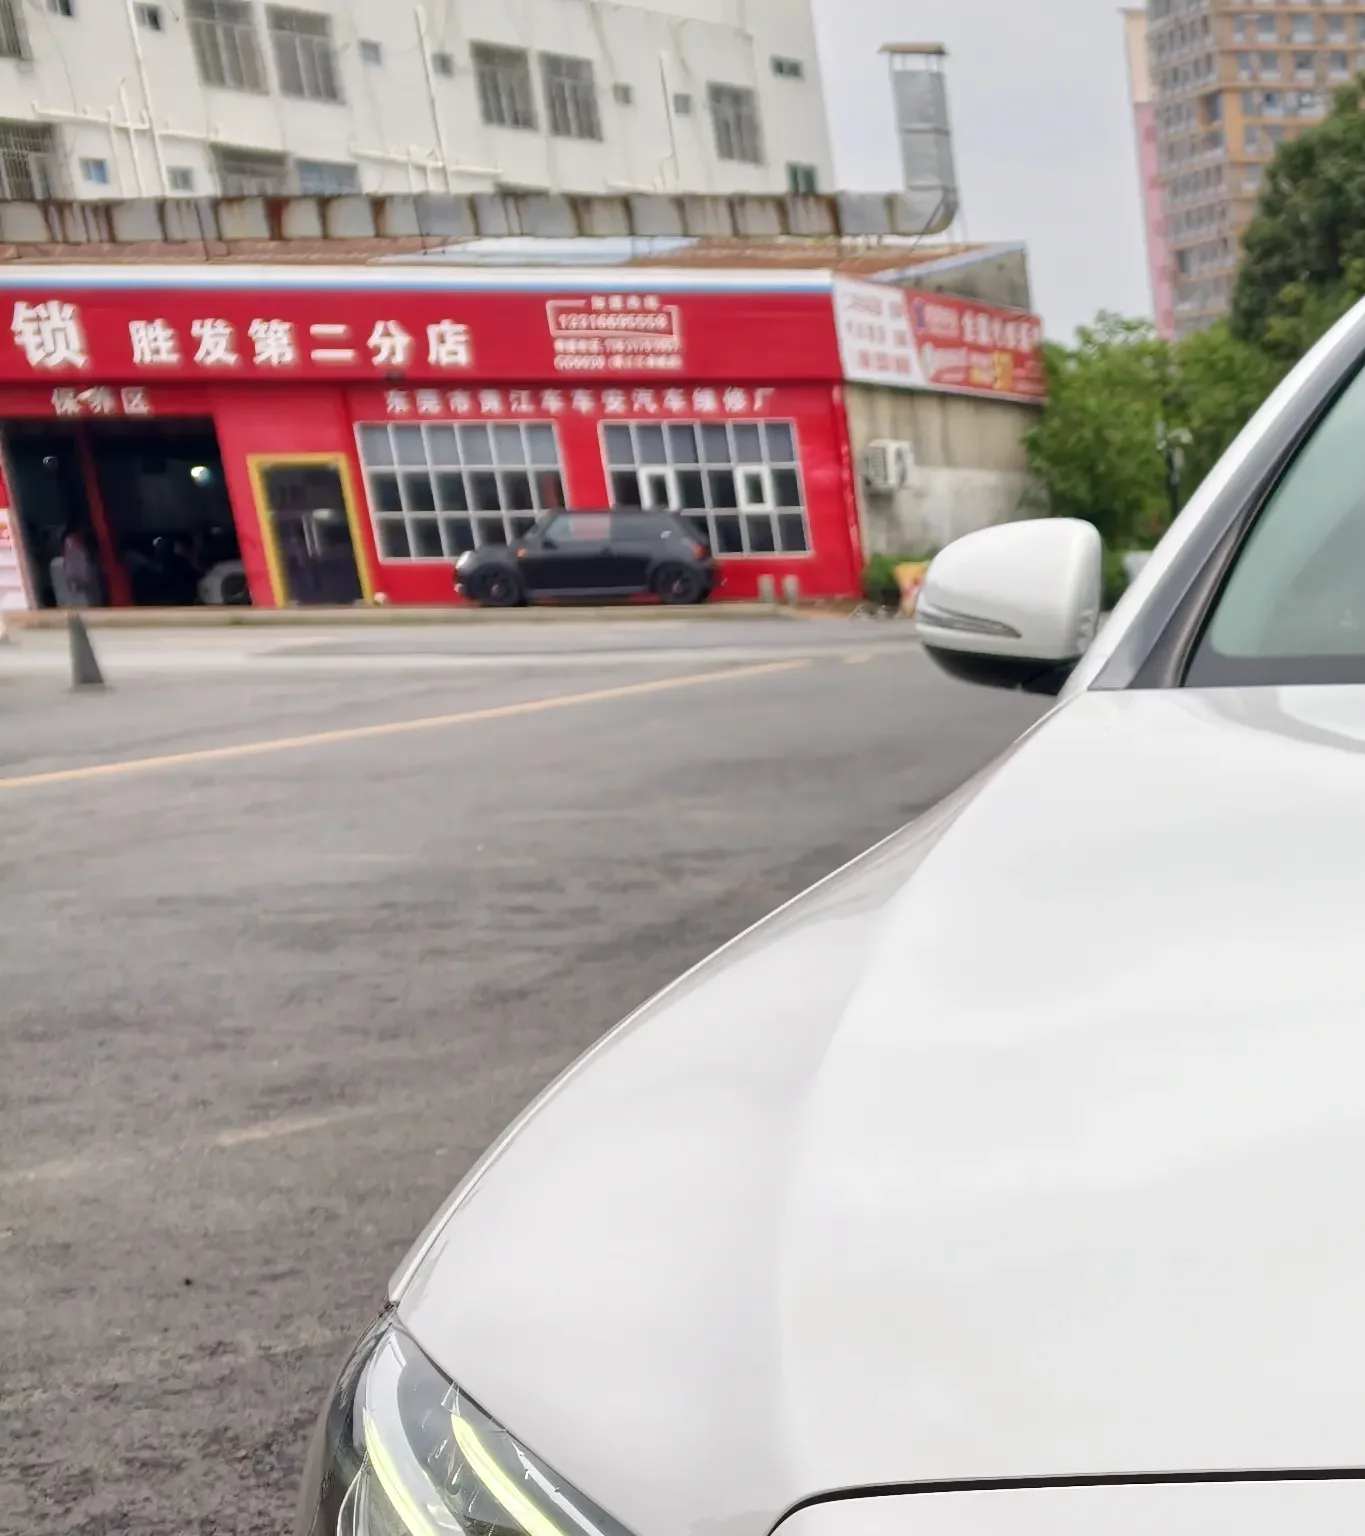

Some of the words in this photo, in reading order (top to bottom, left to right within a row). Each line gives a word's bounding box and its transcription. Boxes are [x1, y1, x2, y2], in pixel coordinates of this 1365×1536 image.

[10, 300, 89, 369] 锁
[128, 317, 473, 368] 胜发第二分店
